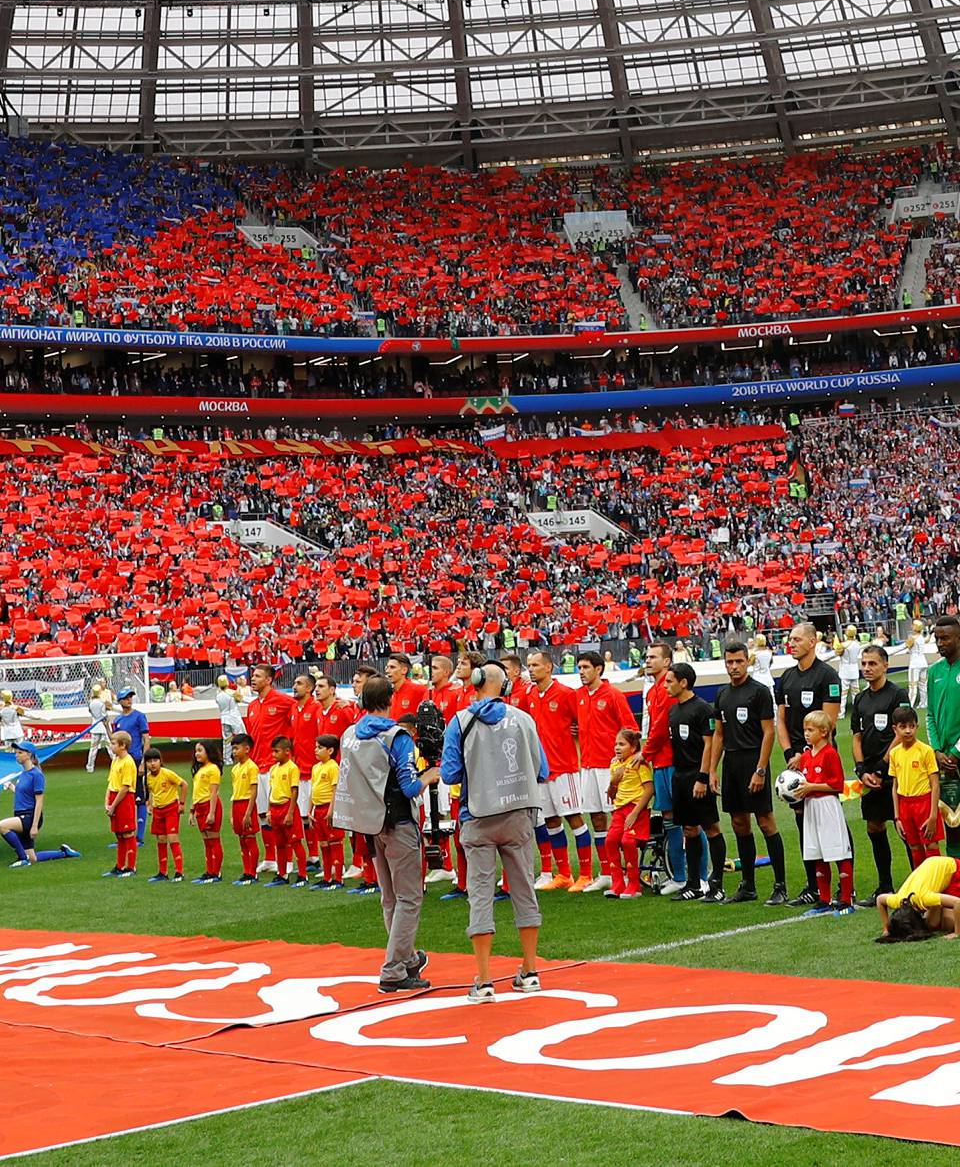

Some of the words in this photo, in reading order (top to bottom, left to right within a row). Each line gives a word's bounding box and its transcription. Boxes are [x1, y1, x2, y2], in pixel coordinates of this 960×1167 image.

[909, 203, 926, 212] 252
[939, 200, 956, 209] 251
[252, 233, 268, 242] 256
[281, 234, 297, 243] 255
[737, 324, 792, 338] МОСКВА
[66, 331, 102, 343] МИРА
[104, 332, 121, 344] ПО
[123, 334, 177, 346] ФУТБОЛУ
[179, 335, 203, 346] FIFA
[205, 336, 231, 347] 2018
[232, 337, 241, 348] В
[731, 386, 759, 397] 2018
[760, 383, 785, 396] FIFA
[787, 379, 829, 393] WORLD
[830, 377, 855, 389] CUP
[199, 401, 249, 412] МОСКВА
[537, 517, 555, 527] 146
[569, 516, 586, 525] 145
[245, 527, 262, 537] 147
[342, 737, 361, 752] 918
[561, 796, 572, 810] 4
